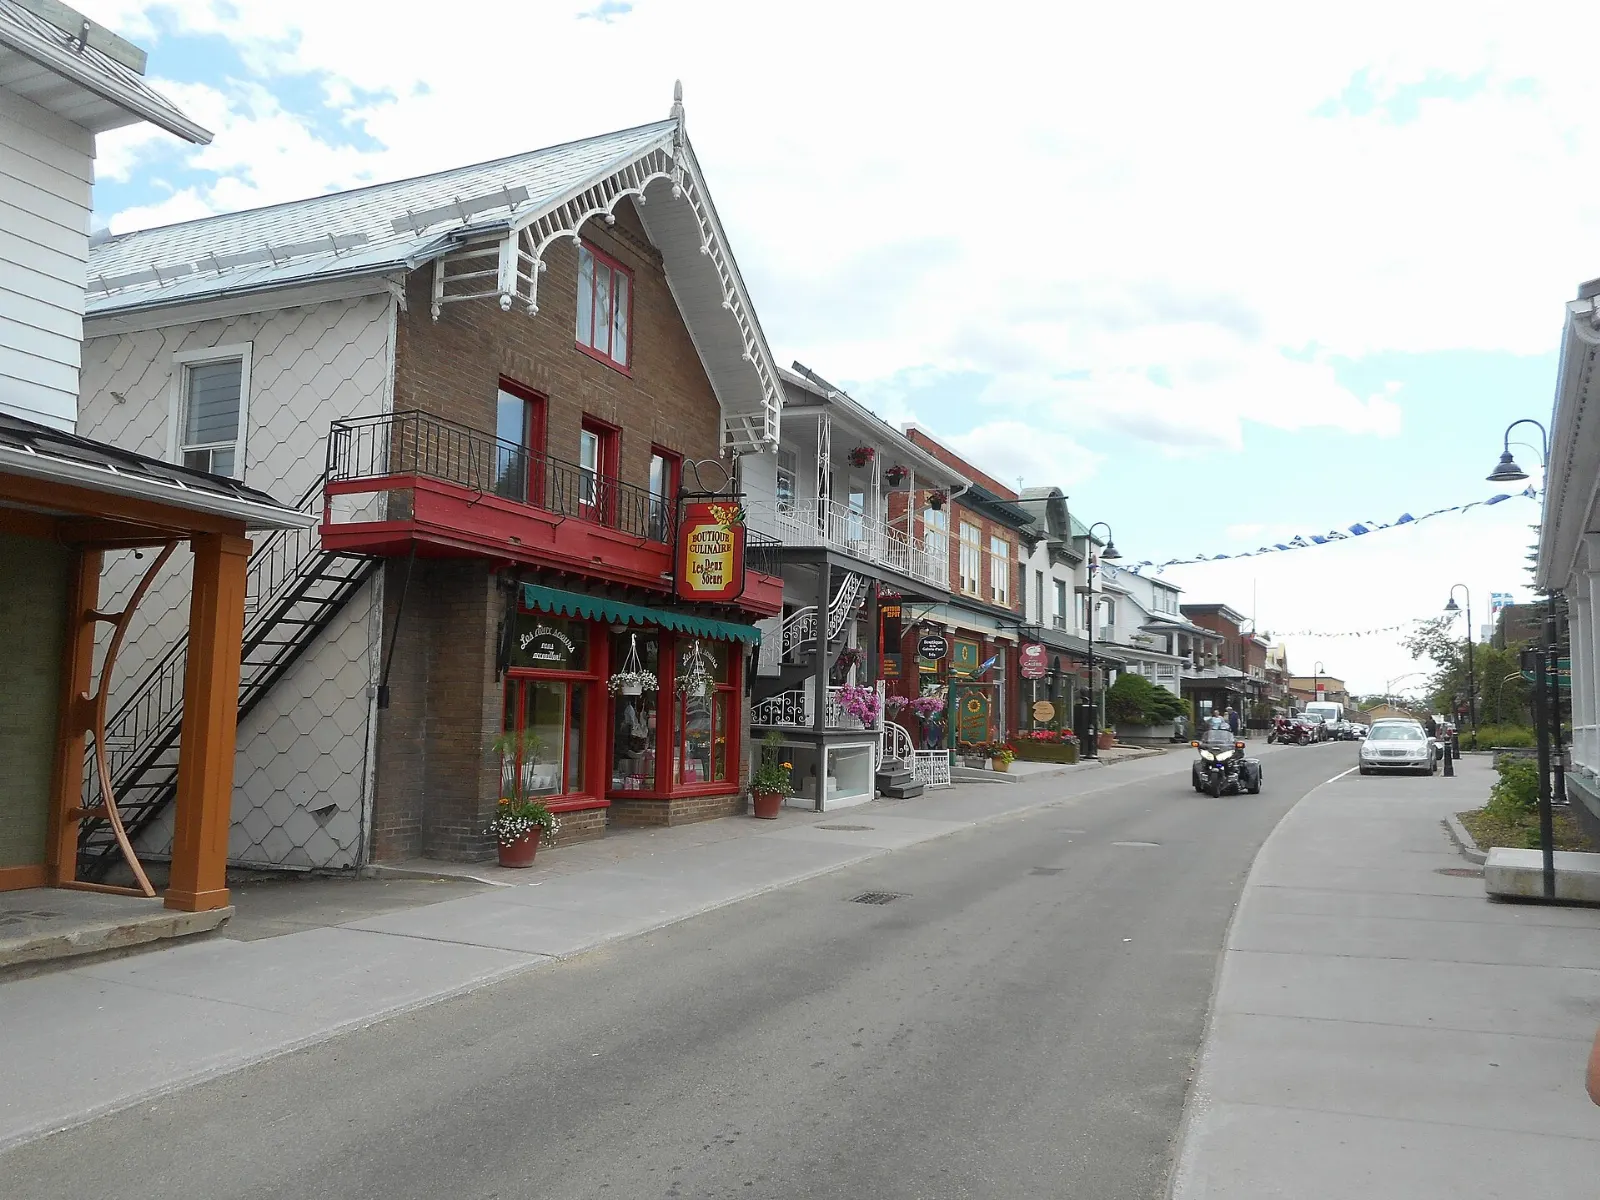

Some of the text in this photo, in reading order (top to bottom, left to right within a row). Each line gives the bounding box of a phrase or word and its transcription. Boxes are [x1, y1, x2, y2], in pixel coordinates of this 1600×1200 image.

[692, 531, 730, 545] BOUTIQUE
[690, 544, 732, 555] CULINAIRE
[692, 558, 722, 574] Les Deux
[520, 632, 534, 650] Les
